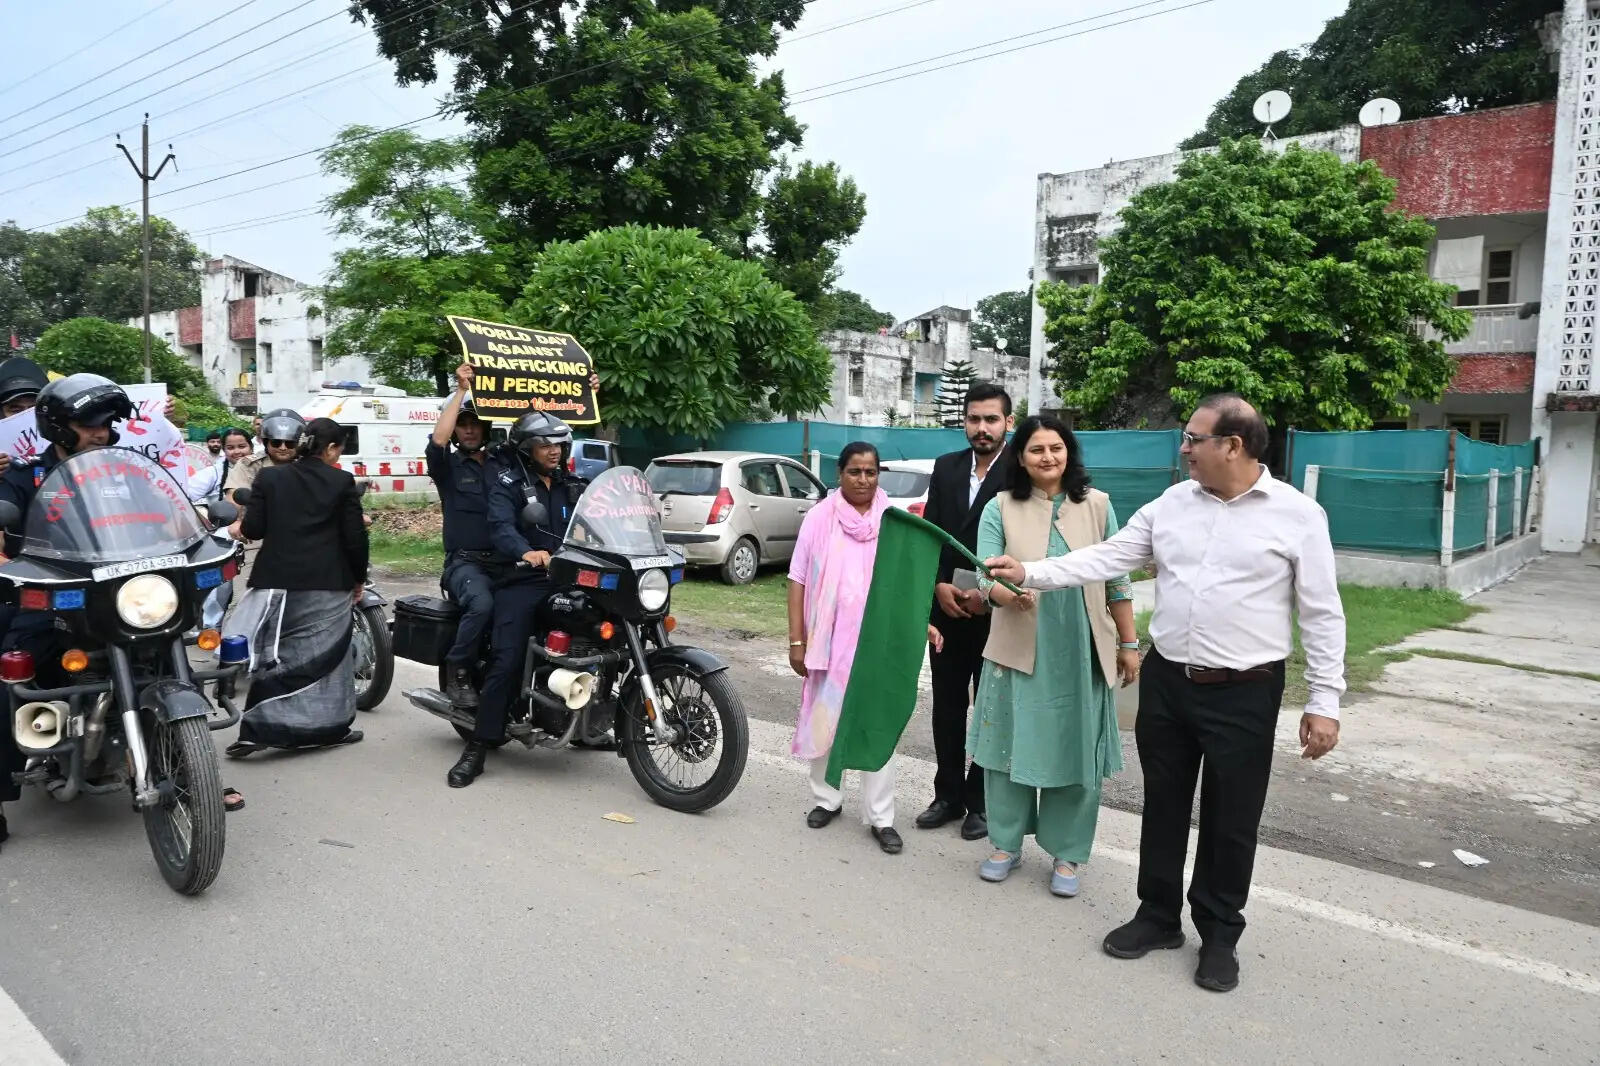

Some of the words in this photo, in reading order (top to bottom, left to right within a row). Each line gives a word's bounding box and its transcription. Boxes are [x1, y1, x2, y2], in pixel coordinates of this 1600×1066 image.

[463, 321, 532, 343] WORLD
[535, 334, 568, 346] DAY
[487, 341, 564, 357] AGAINST
[469, 353, 588, 377] TRAFFICKING
[475, 376, 496, 391] IN
[503, 377, 583, 397] PERSONS
